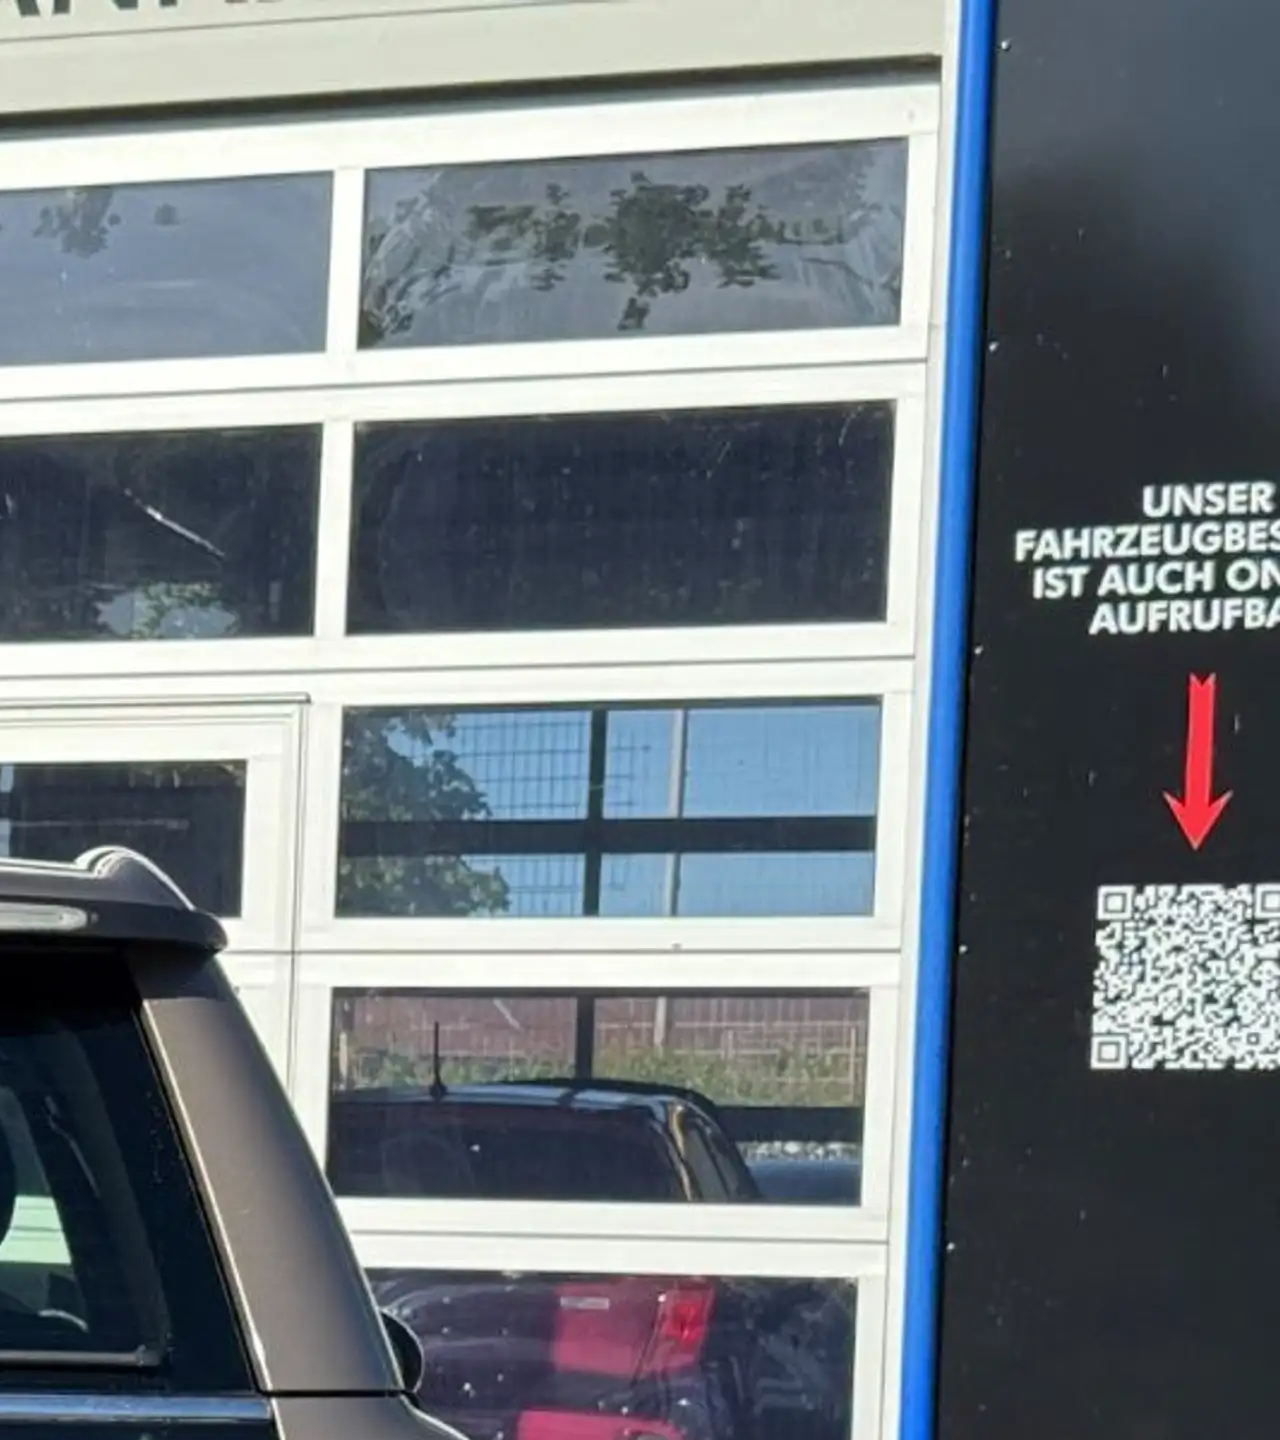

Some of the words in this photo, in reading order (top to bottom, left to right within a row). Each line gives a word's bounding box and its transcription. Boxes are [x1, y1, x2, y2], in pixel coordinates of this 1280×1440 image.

[1142, 482, 1274, 517] UNSER
[1033, 566, 1089, 599] IST
[1098, 561, 1214, 596] AUCH
